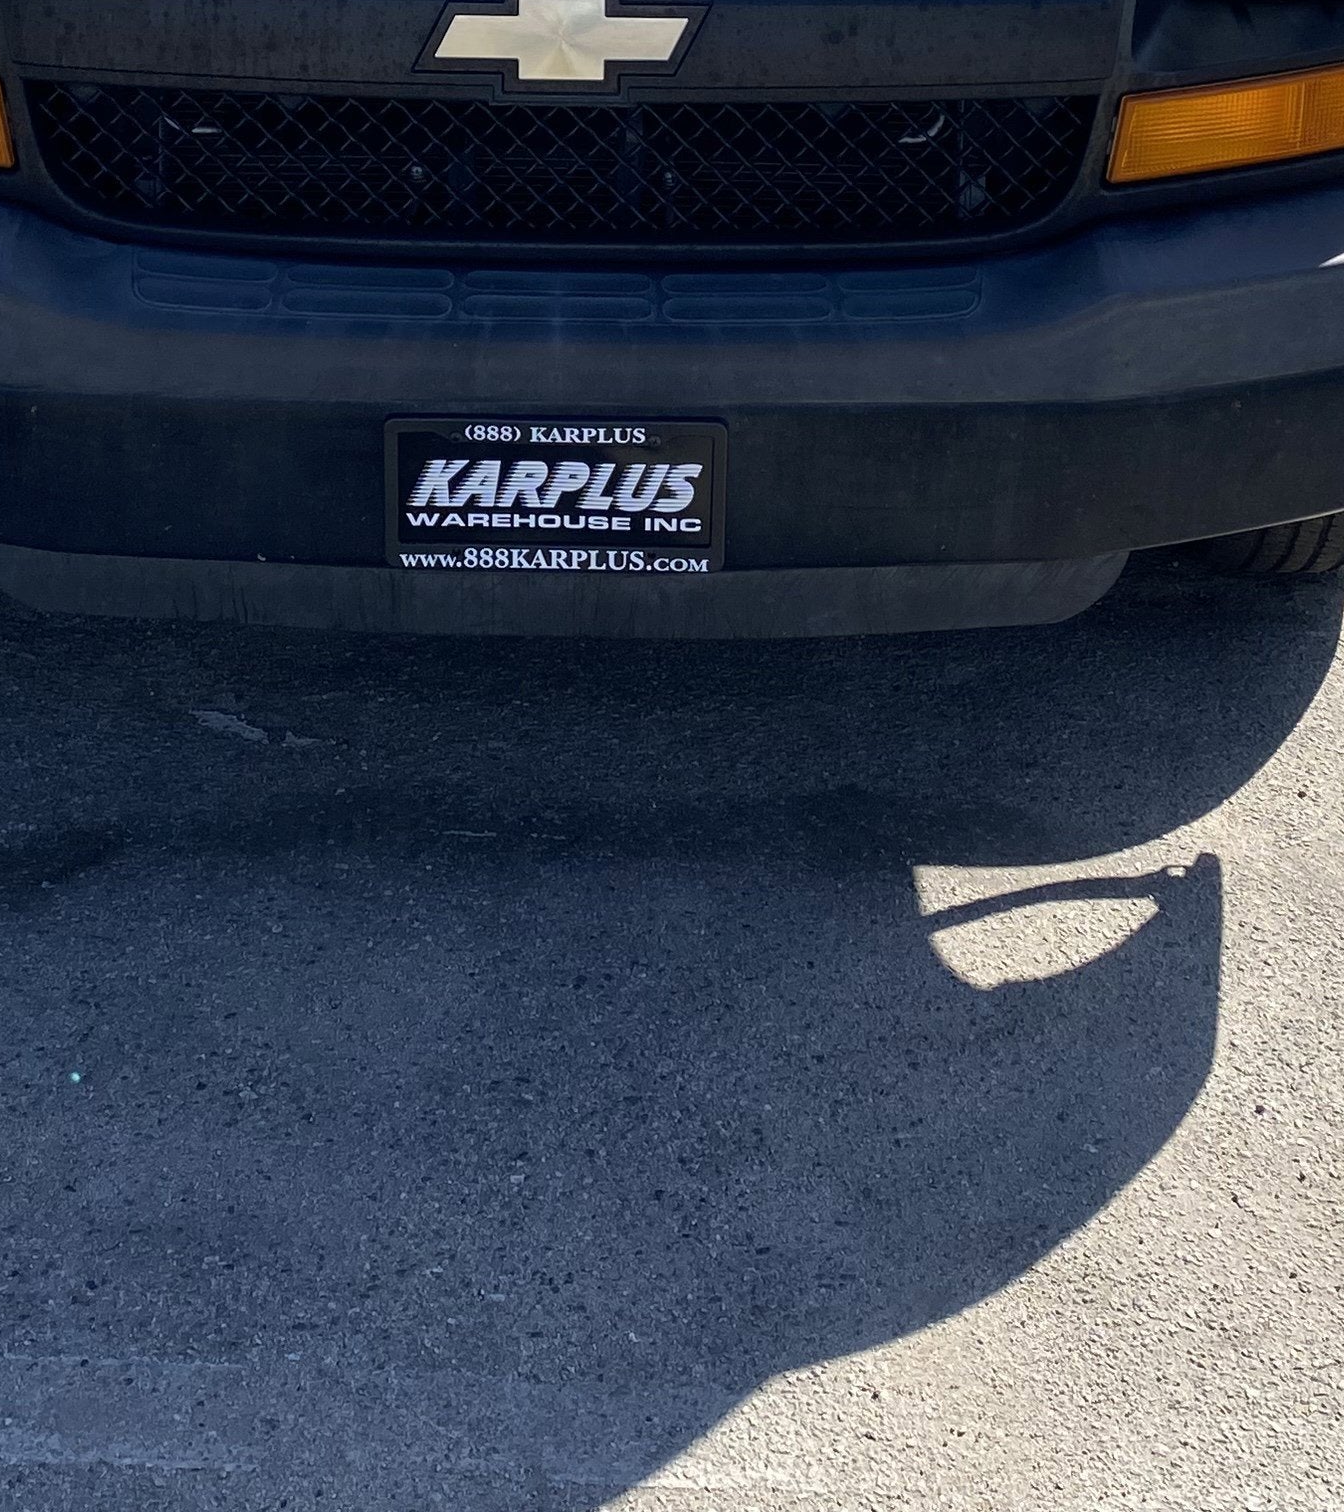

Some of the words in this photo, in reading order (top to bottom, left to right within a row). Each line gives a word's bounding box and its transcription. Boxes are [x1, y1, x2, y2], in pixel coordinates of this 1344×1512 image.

[464, 424, 521, 442] (888)
[529, 426, 646, 444] KARPLUS
[406, 458, 703, 513] KARPLUS
[406, 512, 632, 531] WAREHOUSE
[644, 517, 702, 532] INC
